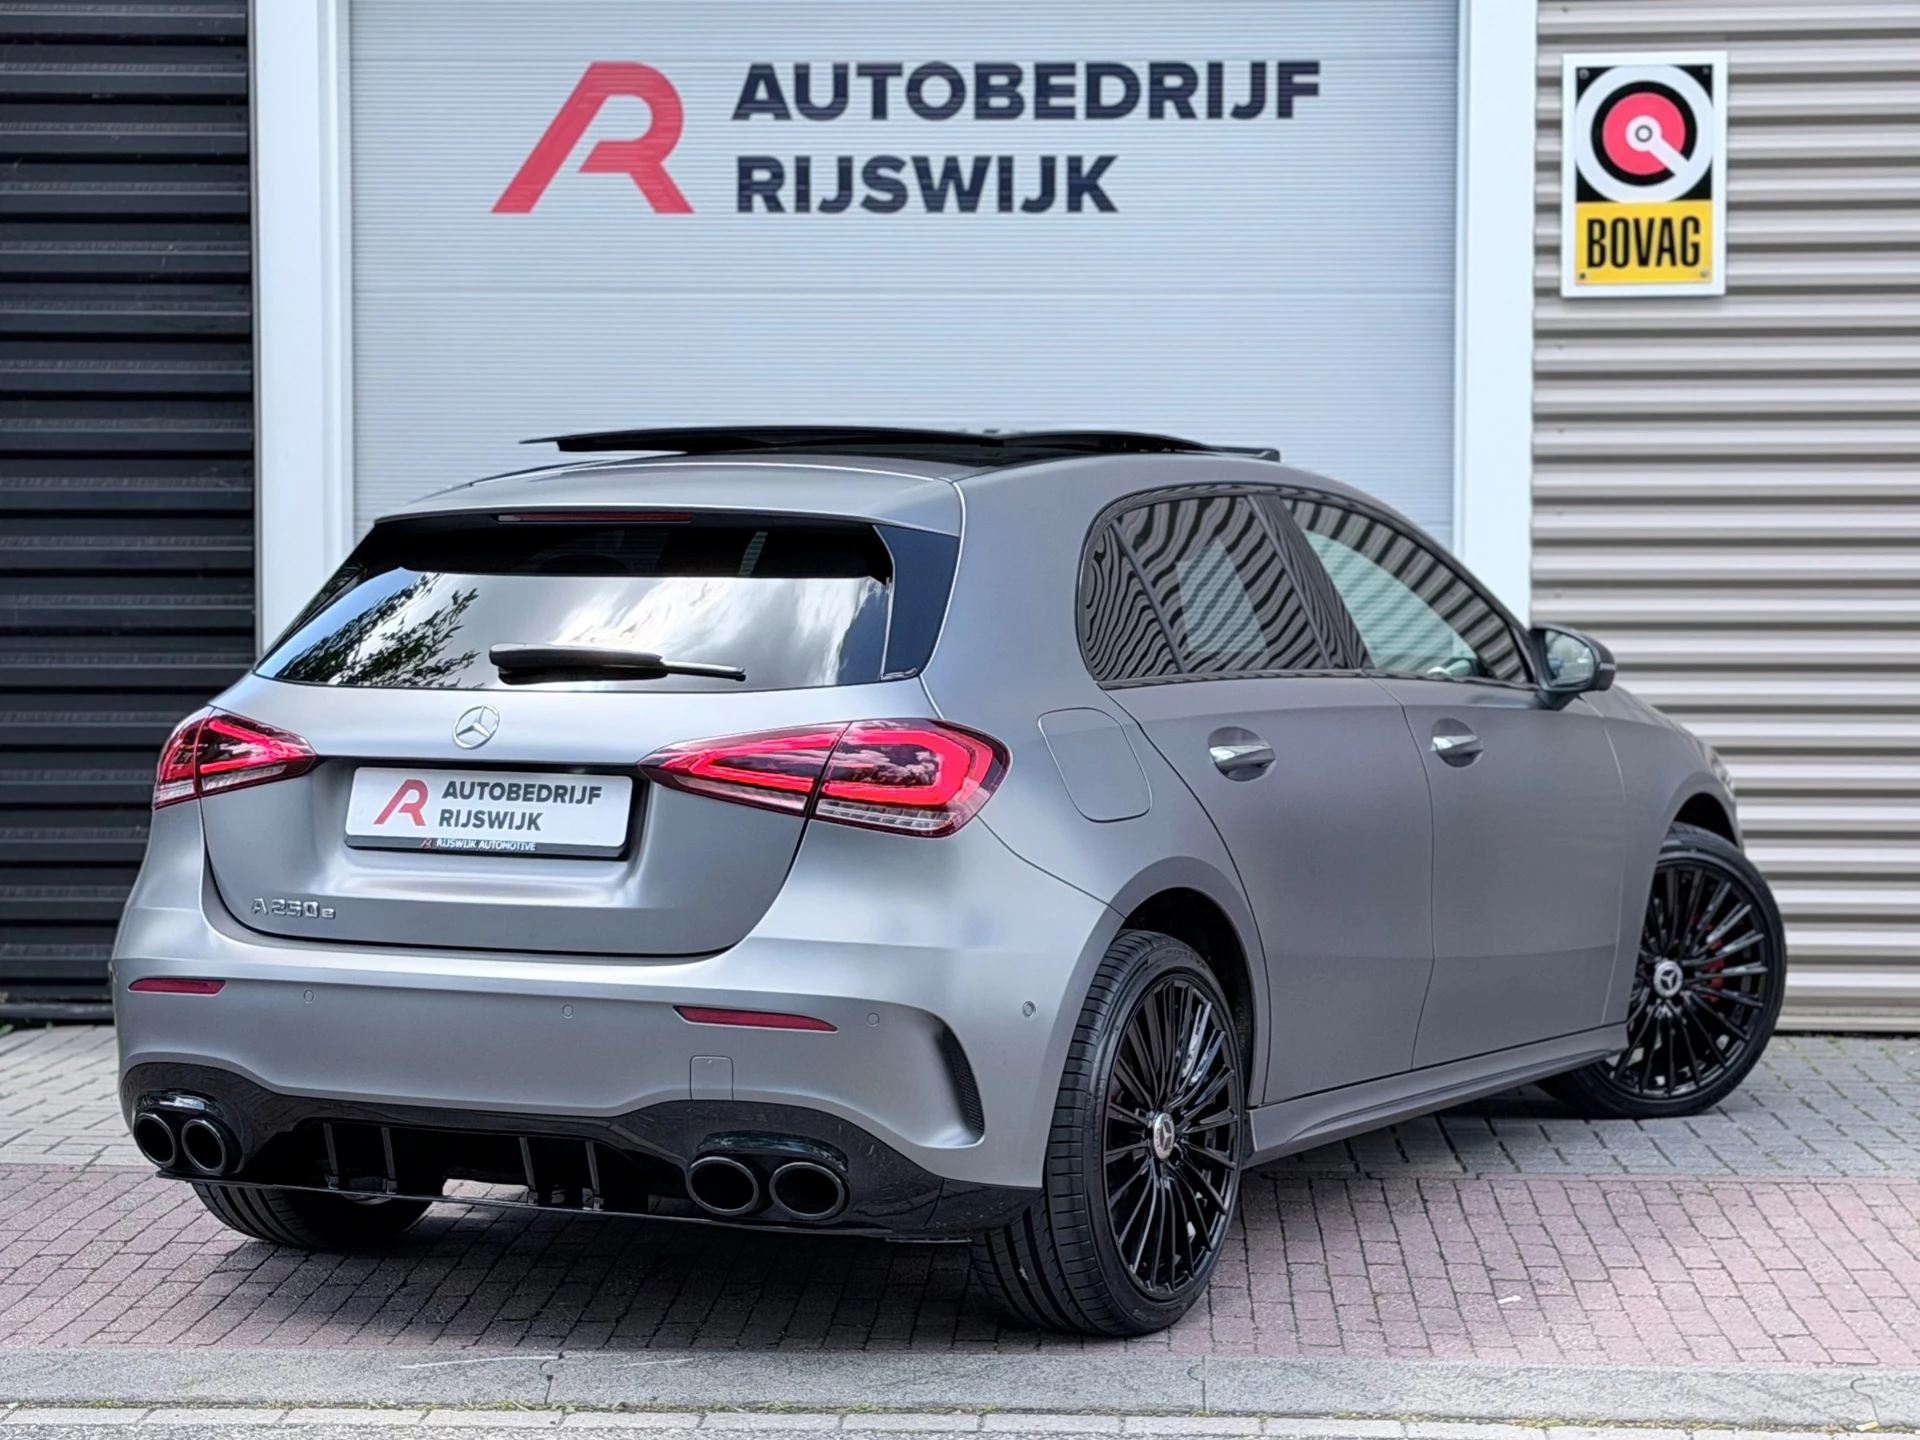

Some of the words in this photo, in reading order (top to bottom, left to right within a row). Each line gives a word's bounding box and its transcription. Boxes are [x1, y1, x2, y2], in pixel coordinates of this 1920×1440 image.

[732, 61, 1320, 121] AUTOBEDRIJF
[736, 155, 1119, 214] RIJSWIJK
[1587, 216, 1701, 268] BOVAG
[441, 781, 602, 804] AUTOBEDRIJF
[438, 808, 543, 831] RIJSWIJK
[436, 838, 476, 849] RIJSWIJK
[478, 840, 536, 851] AUTOMOTIVE
[252, 898, 268, 915] A
